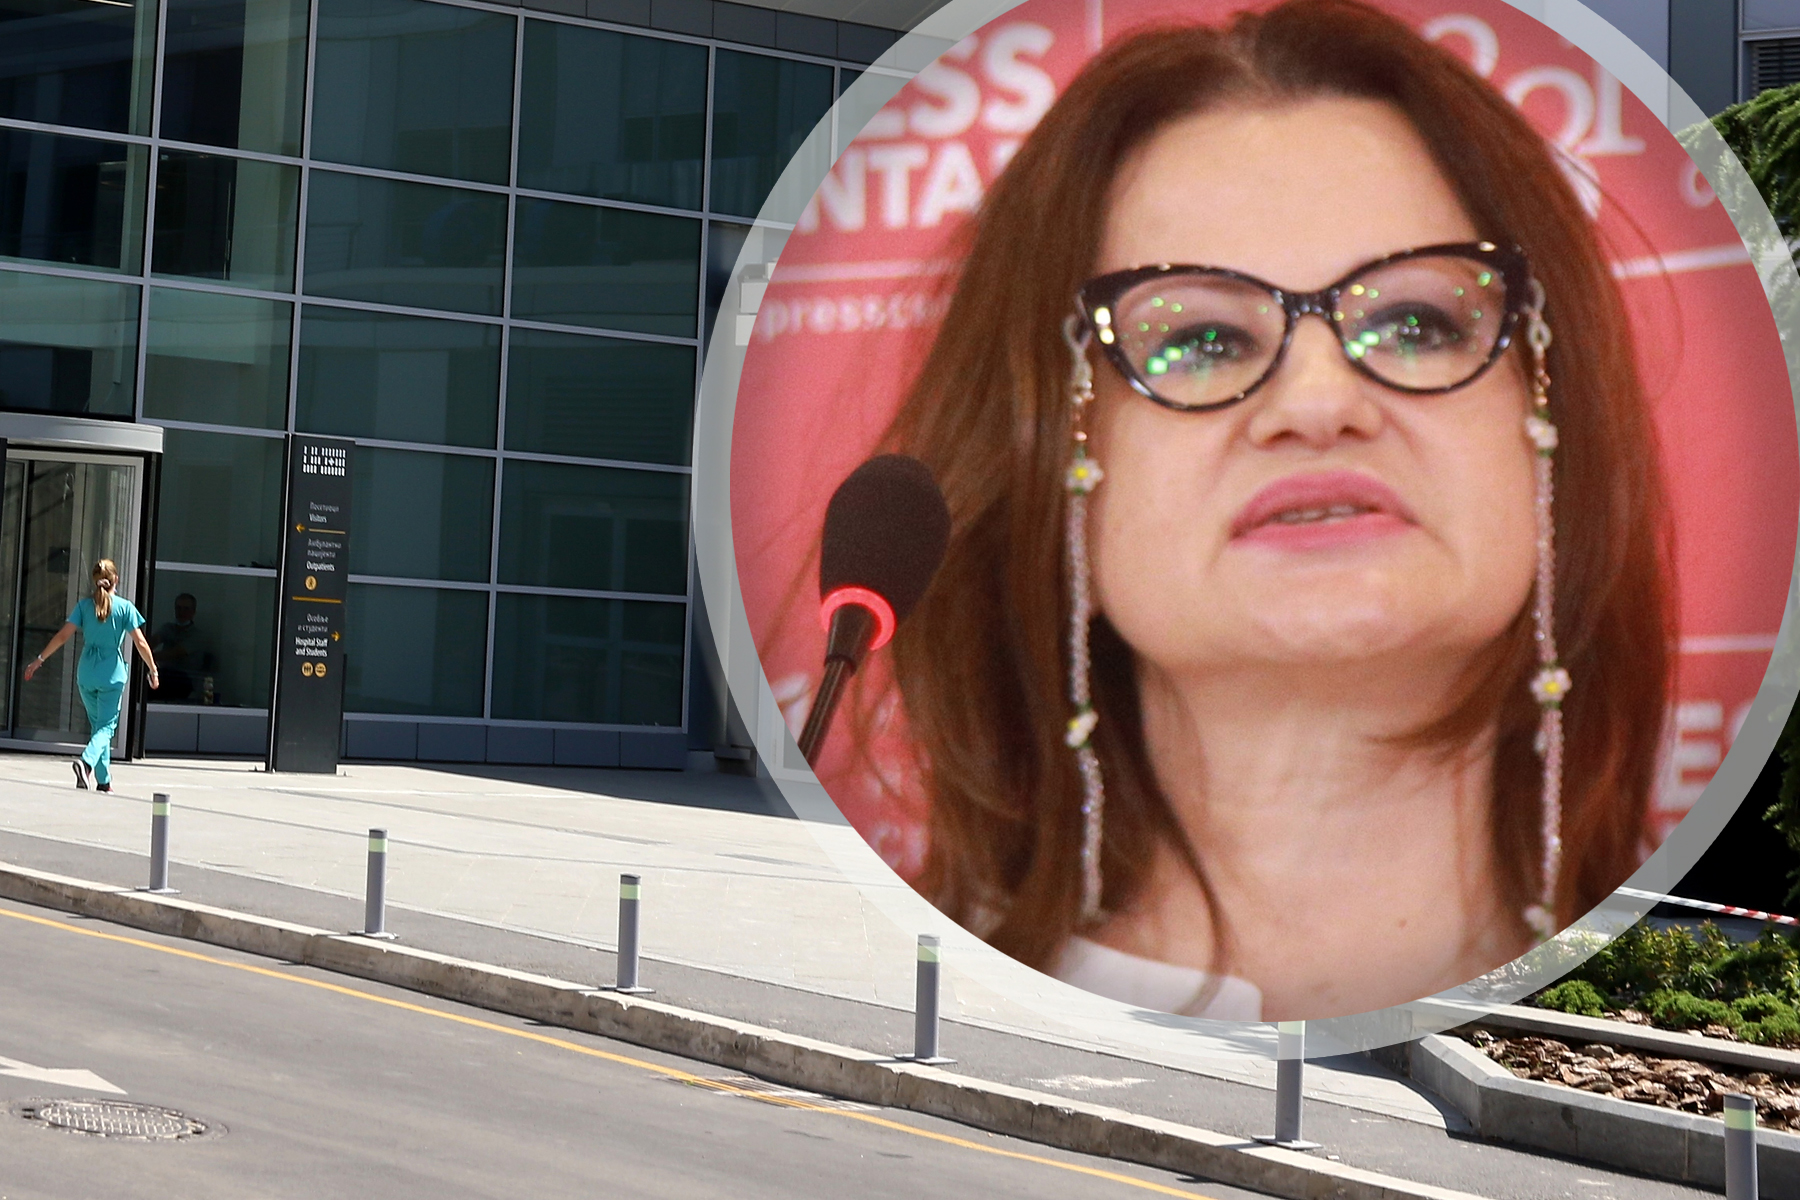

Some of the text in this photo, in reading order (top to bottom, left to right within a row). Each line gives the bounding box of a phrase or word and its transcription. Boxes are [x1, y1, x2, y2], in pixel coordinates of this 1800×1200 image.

[308, 513, 328, 524] Visitors
[306, 560, 335, 572] Outpatients
[295, 636, 328, 647] Hospital Staff
[295, 647, 328, 657] and Students
